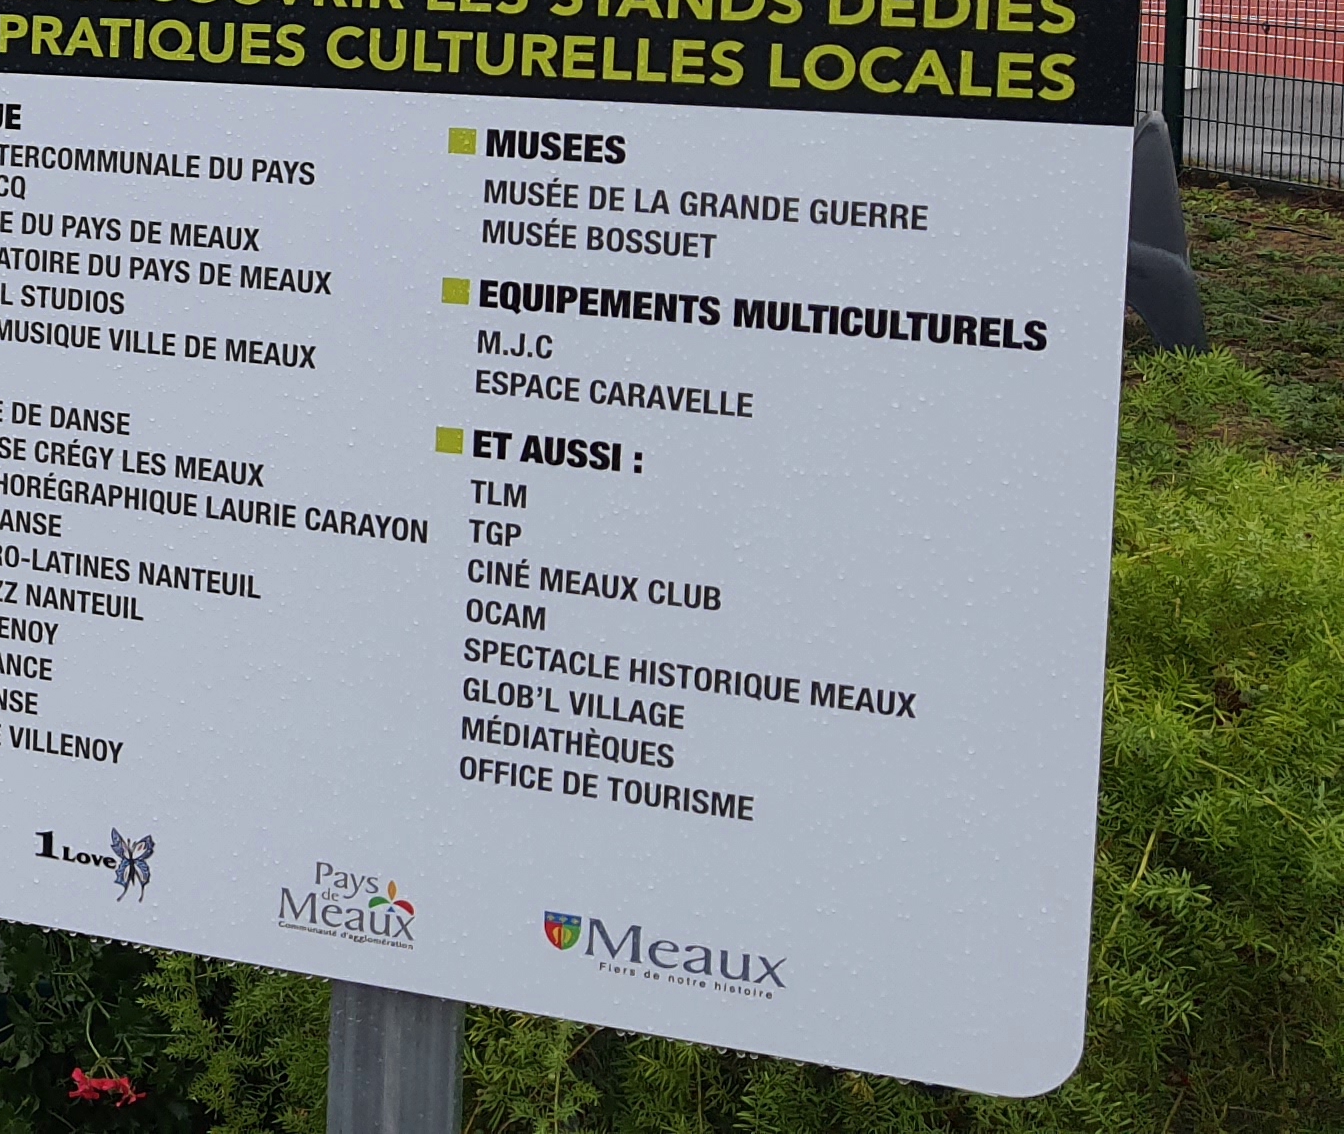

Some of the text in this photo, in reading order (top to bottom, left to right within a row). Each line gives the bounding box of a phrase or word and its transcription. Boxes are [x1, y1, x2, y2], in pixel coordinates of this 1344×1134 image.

[326, 23, 744, 89] CULTURELLES
[769, 43, 1076, 102] LOCALES
[485, 128, 627, 165] MUSEES
[209, 157, 243, 182] DU
[252, 159, 316, 185] PAYS
[484, 177, 929, 232] MUSÉE DE LA GRANDE GUERRE
[21, 212, 54, 237] DU
[61, 215, 121, 242] PAYS
[130, 220, 162, 244] DE
[170, 223, 260, 251] MEAUX
[482, 217, 717, 260] MUSÉE BOSSUET
[88, 253, 121, 279] DU
[129, 256, 190, 285] PAYS
[200, 262, 232, 287] DE
[240, 266, 332, 296] MEAUX
[20, 284, 125, 315] STUDIOS
[478, 279, 1049, 352] EQUIPEMENTS MULTICULTURELS
[109, 328, 175, 356] VILLE
[184, 336, 216, 361] DE
[225, 340, 317, 369] MEAUX
[477, 330, 554, 360] M.J.C
[475, 369, 754, 419] ESPACE CARAVELLE
[11, 401, 42, 426] DE
[50, 404, 131, 437] DANSE
[34, 436, 114, 468] CRÉGY
[121, 449, 167, 477] LES
[175, 455, 265, 488] MEAUX
[473, 430, 513, 460] ET
[520, 434, 622, 472] AUSSI
[470, 479, 527, 509] TLM
[206, 495, 297, 528] LAURIE
[304, 507, 429, 544] CARAYON
[469, 518, 523, 548] TGP
[138, 563, 262, 600] NANTEUIL
[468, 558, 722, 612] CINÉ MEAUX CLUB
[25, 585, 144, 622] NANTEUIL
[466, 598, 547, 631] OCAM
[463, 637, 917, 720] SPECTACLE HISTORIQUE MEAUX
[463, 677, 685, 731] GLOB'L VILLAGE
[8, 725, 124, 765] VILLENOY
[461, 714, 675, 769] MÉDIATHÈQUES
[459, 755, 755, 822] OFFICE DE TOURISME
[35, 831, 60, 860] 1
[315, 861, 379, 899] Pays
[322, 888, 339, 901] de
[278, 887, 415, 941] Meaux
[278, 921, 337, 937] Communauté
[584, 917, 787, 988] Meaux
[599, 962, 773, 1000] Fiers de notre histoire
